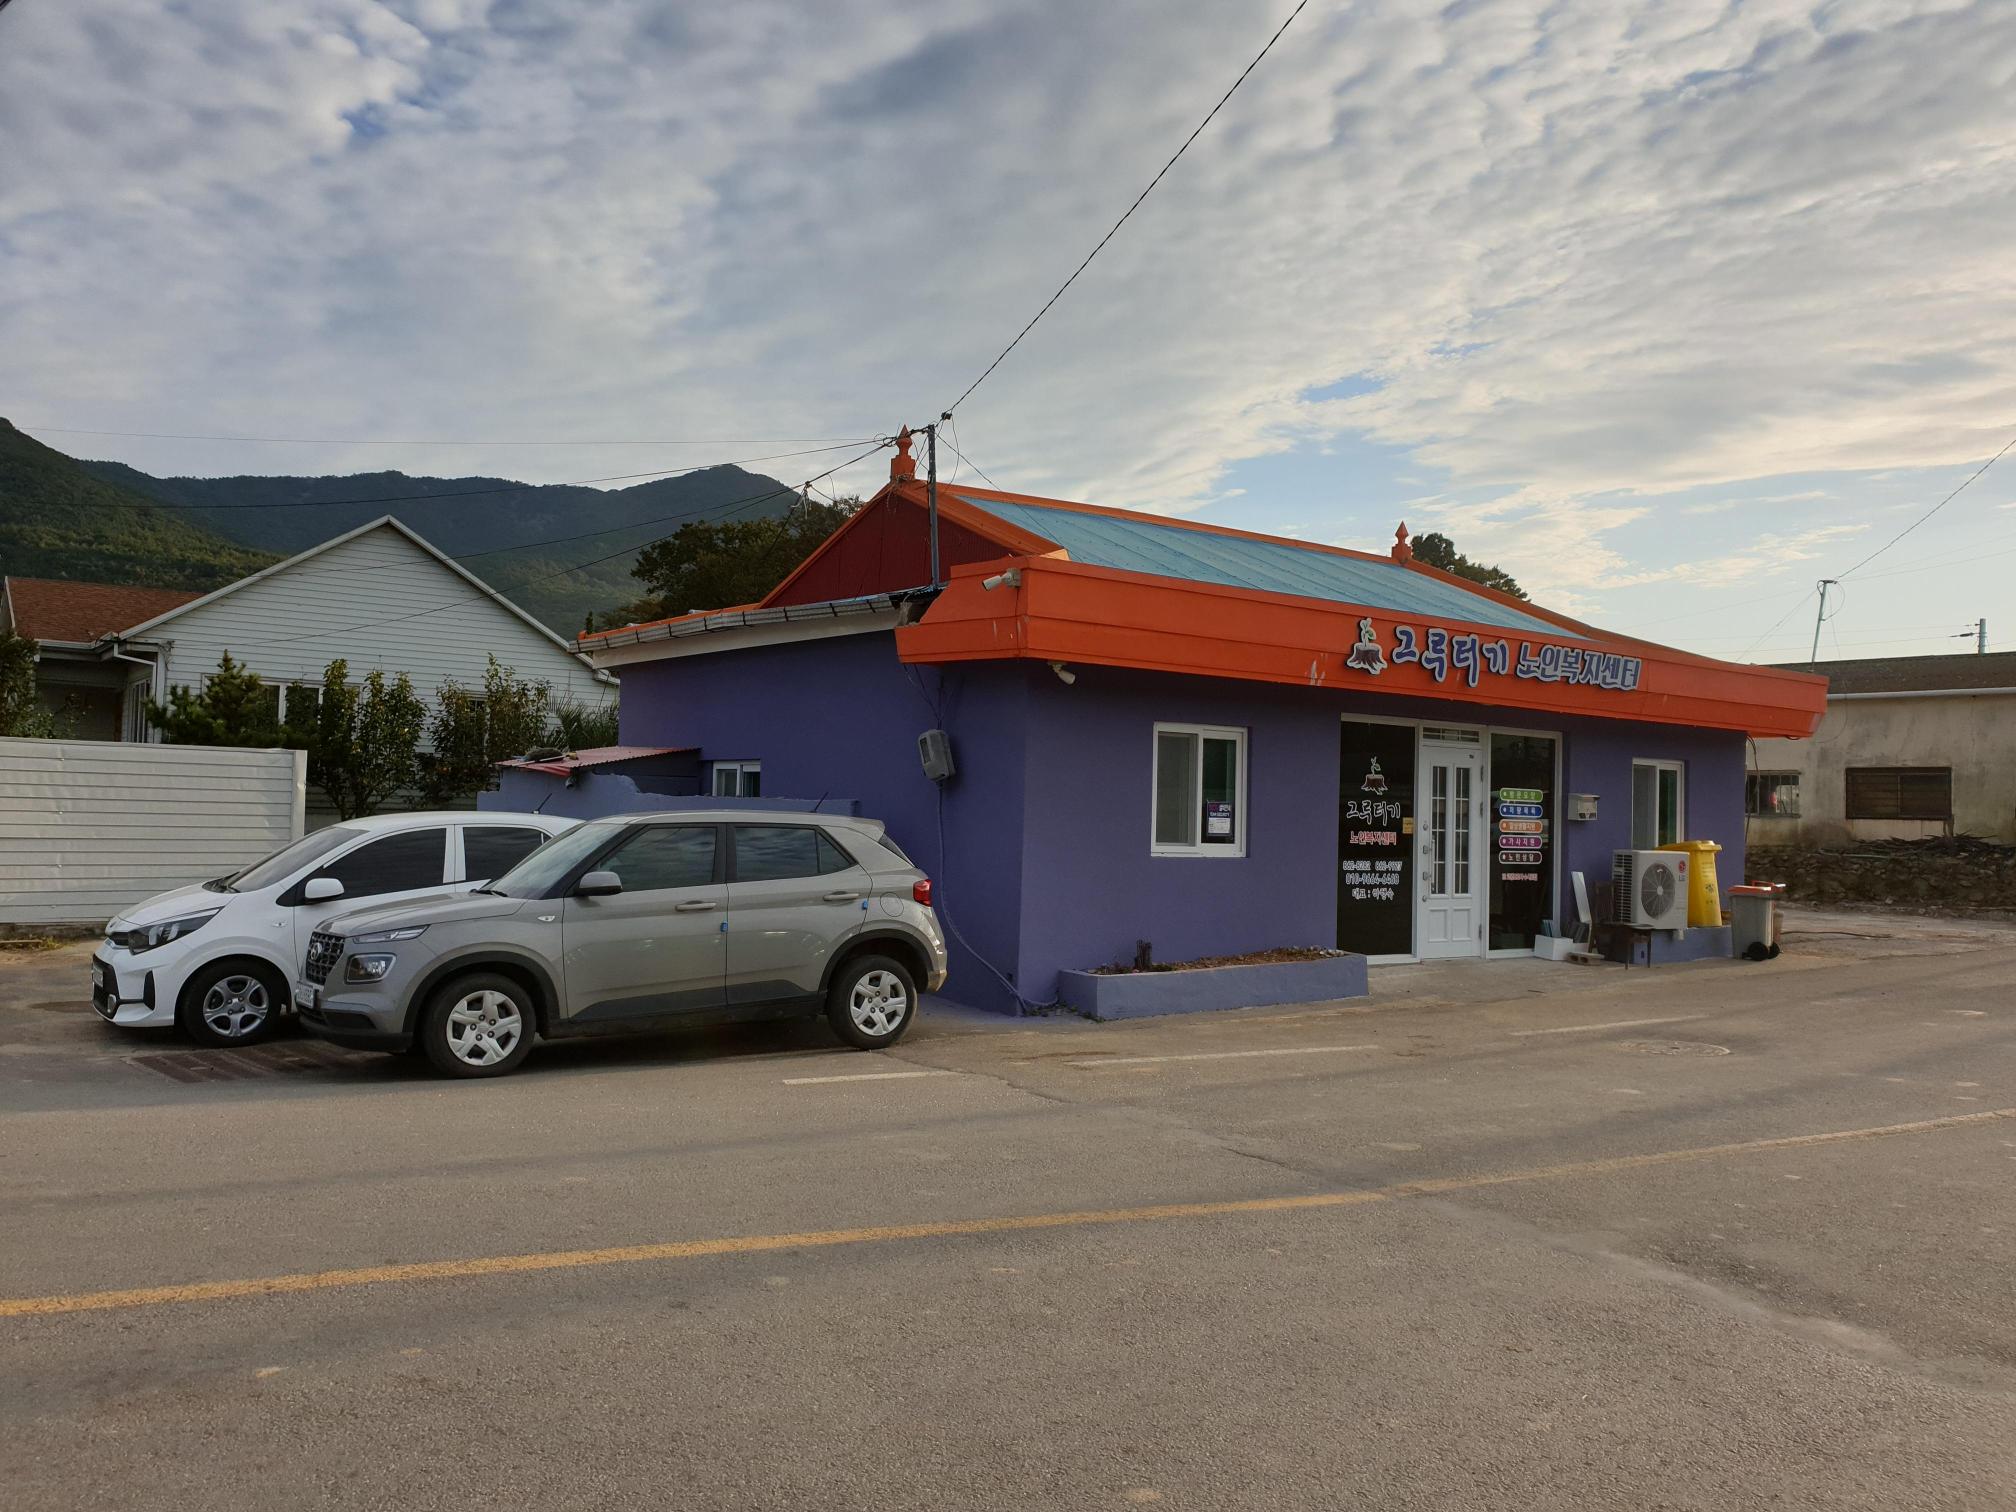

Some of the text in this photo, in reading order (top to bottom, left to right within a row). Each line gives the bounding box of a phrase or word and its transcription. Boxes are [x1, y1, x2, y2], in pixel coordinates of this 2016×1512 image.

[1392, 625, 1642, 690] 그루터기 노인복지센터
[1346, 799, 1401, 826] 그루터기
[1350, 831, 1397, 846] 노인복지센터
